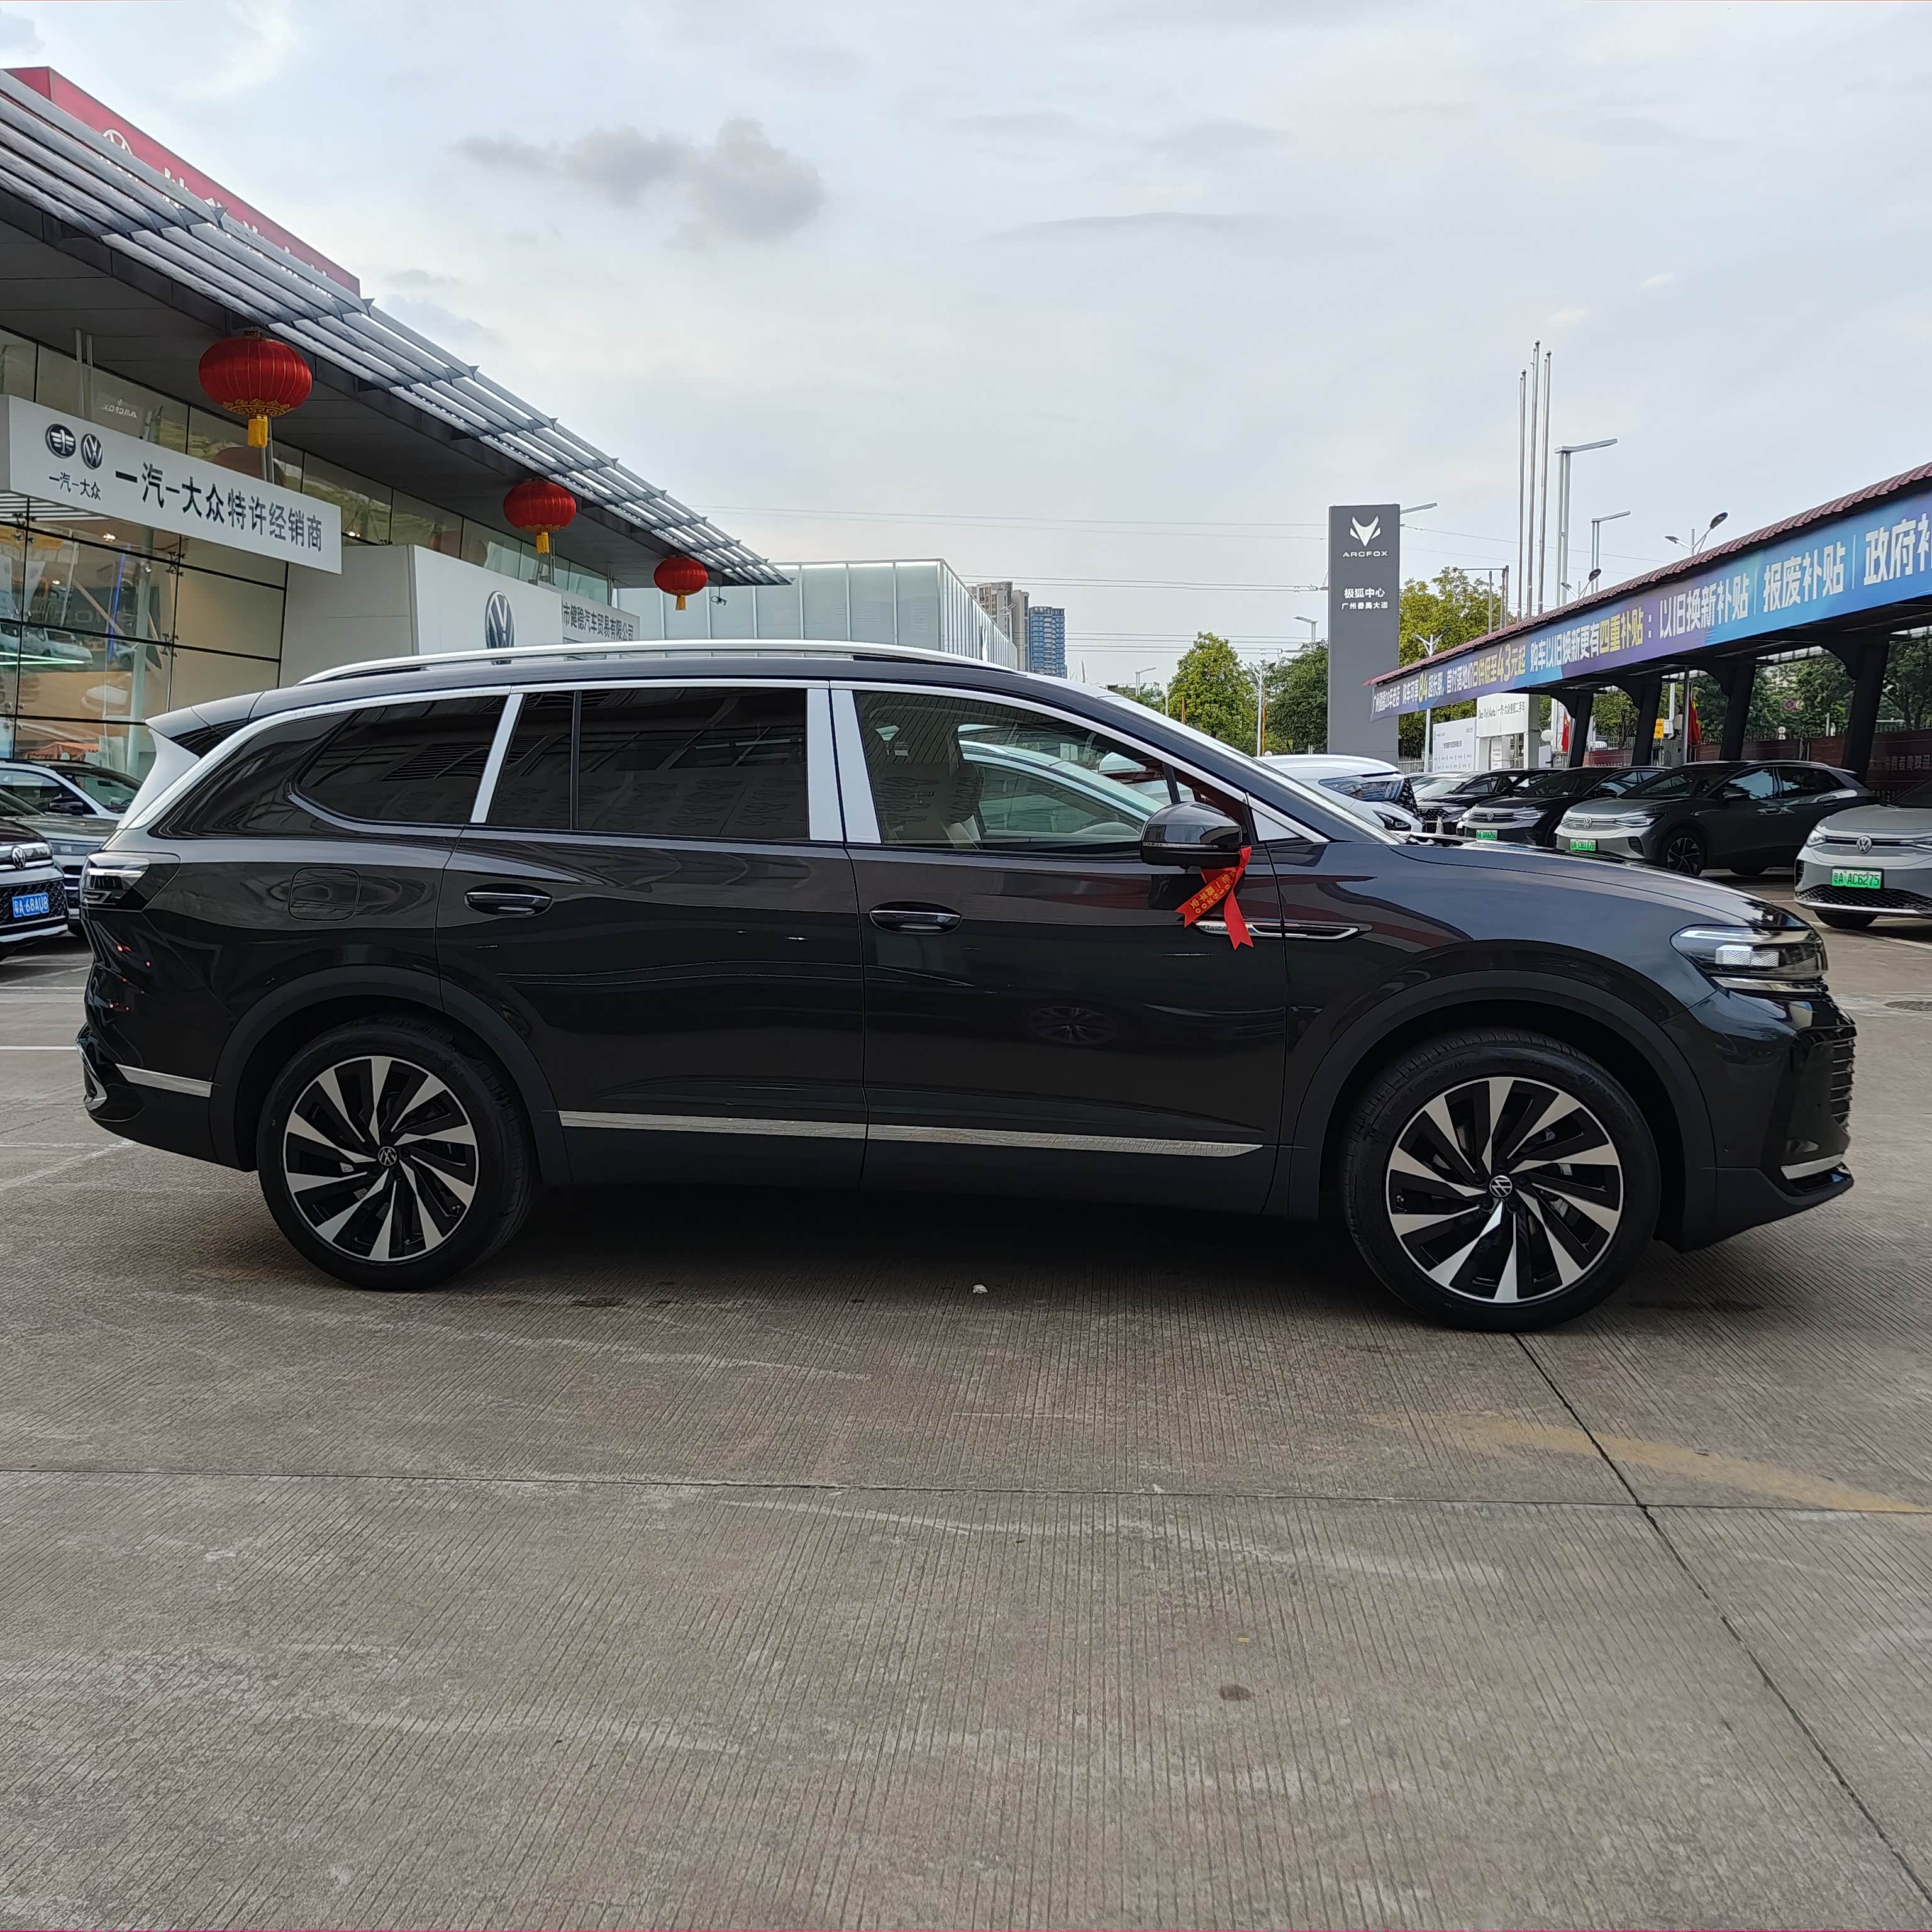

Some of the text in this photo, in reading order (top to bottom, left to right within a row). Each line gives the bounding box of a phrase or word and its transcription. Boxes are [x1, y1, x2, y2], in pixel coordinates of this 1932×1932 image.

[48, 472, 101, 501] 一汽-大众
[115, 462, 323, 552] 一汽-大众特许经销商
[1342, 550, 1389, 558] ARCFOX
[1763, 541, 1846, 613] 报废补贴
[1344, 587, 1385, 599] 极狐中心
[1341, 601, 1389, 610] 广州番禺大道
